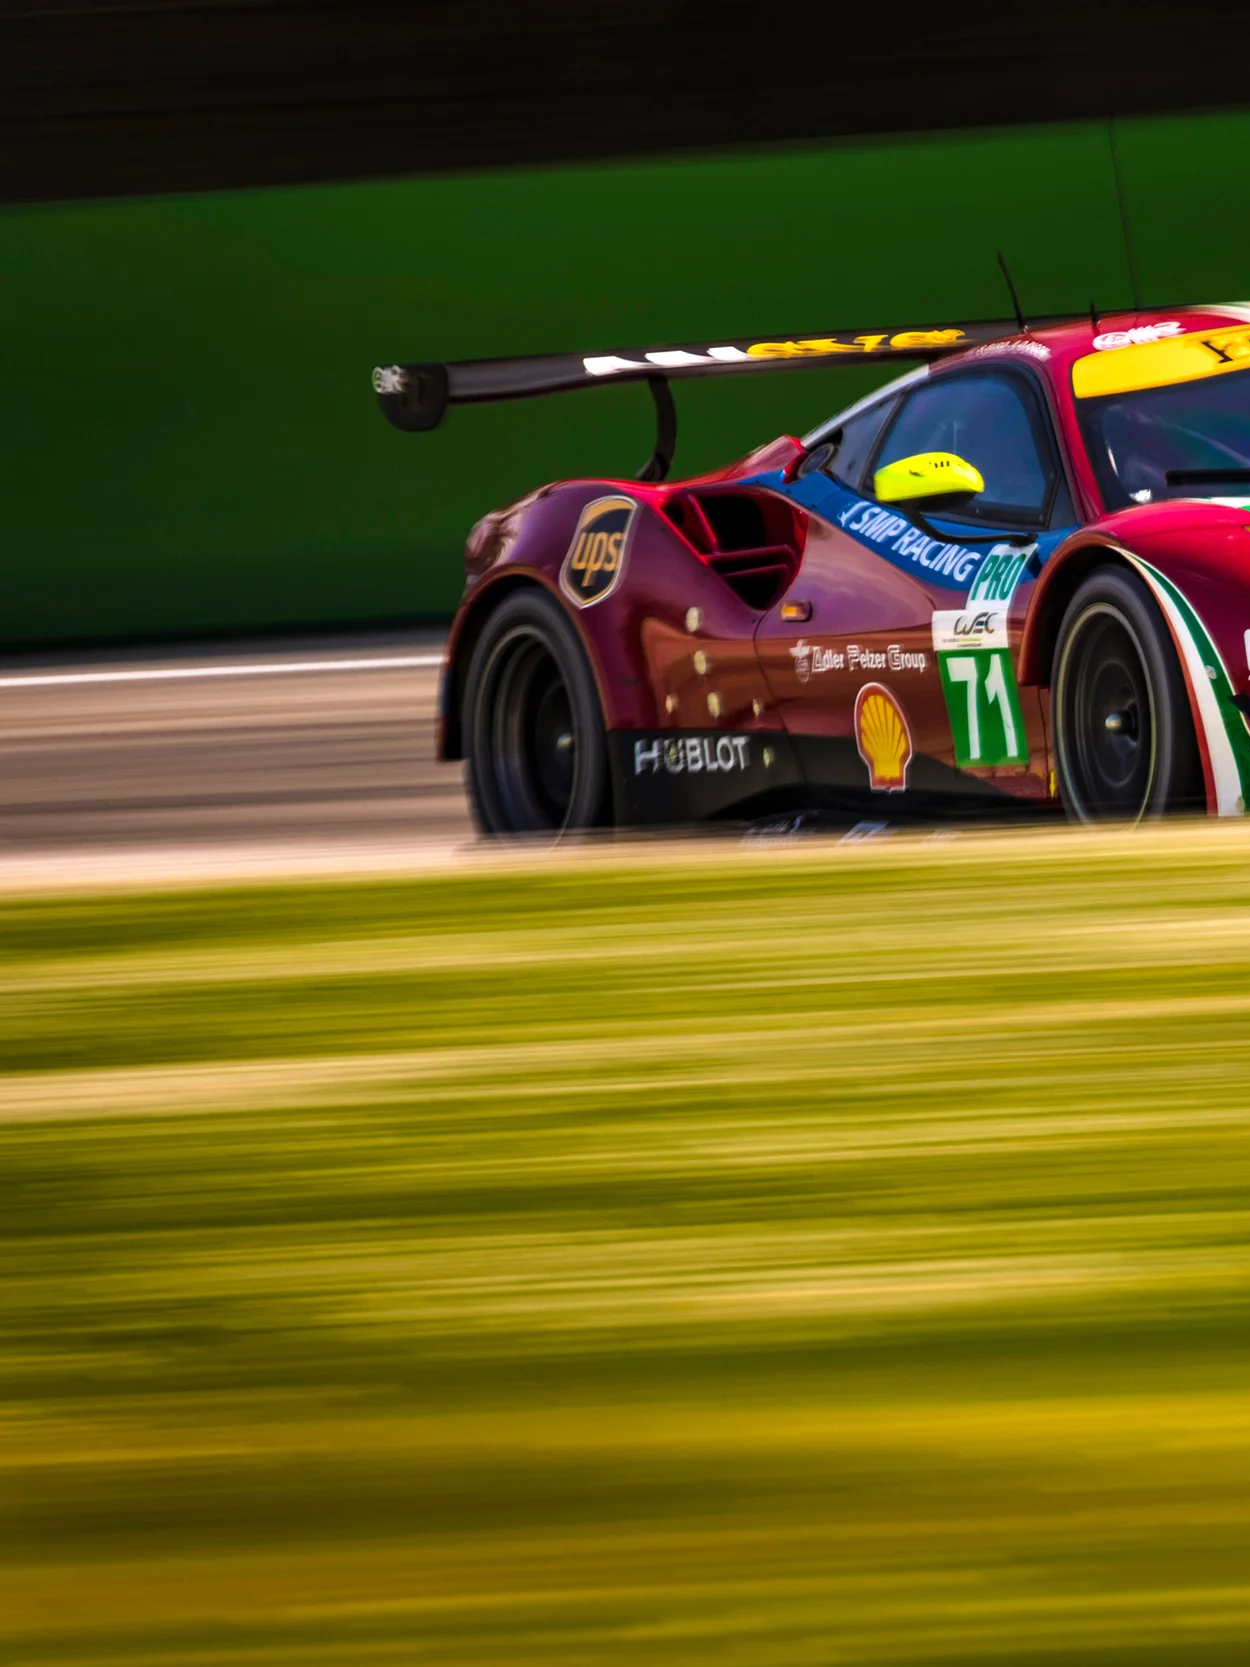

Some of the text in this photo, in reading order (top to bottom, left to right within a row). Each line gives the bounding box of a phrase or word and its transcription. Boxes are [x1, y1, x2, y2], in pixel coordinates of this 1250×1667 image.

[571, 531, 625, 587] ups
[849, 506, 981, 582] SMP RACING
[971, 552, 1027, 601] PRO
[953, 611, 998, 635] WEC
[811, 644, 927, 673] Adler Pelzer Group
[946, 654, 1018, 760] 71
[634, 735, 751, 776] HUBLOT
